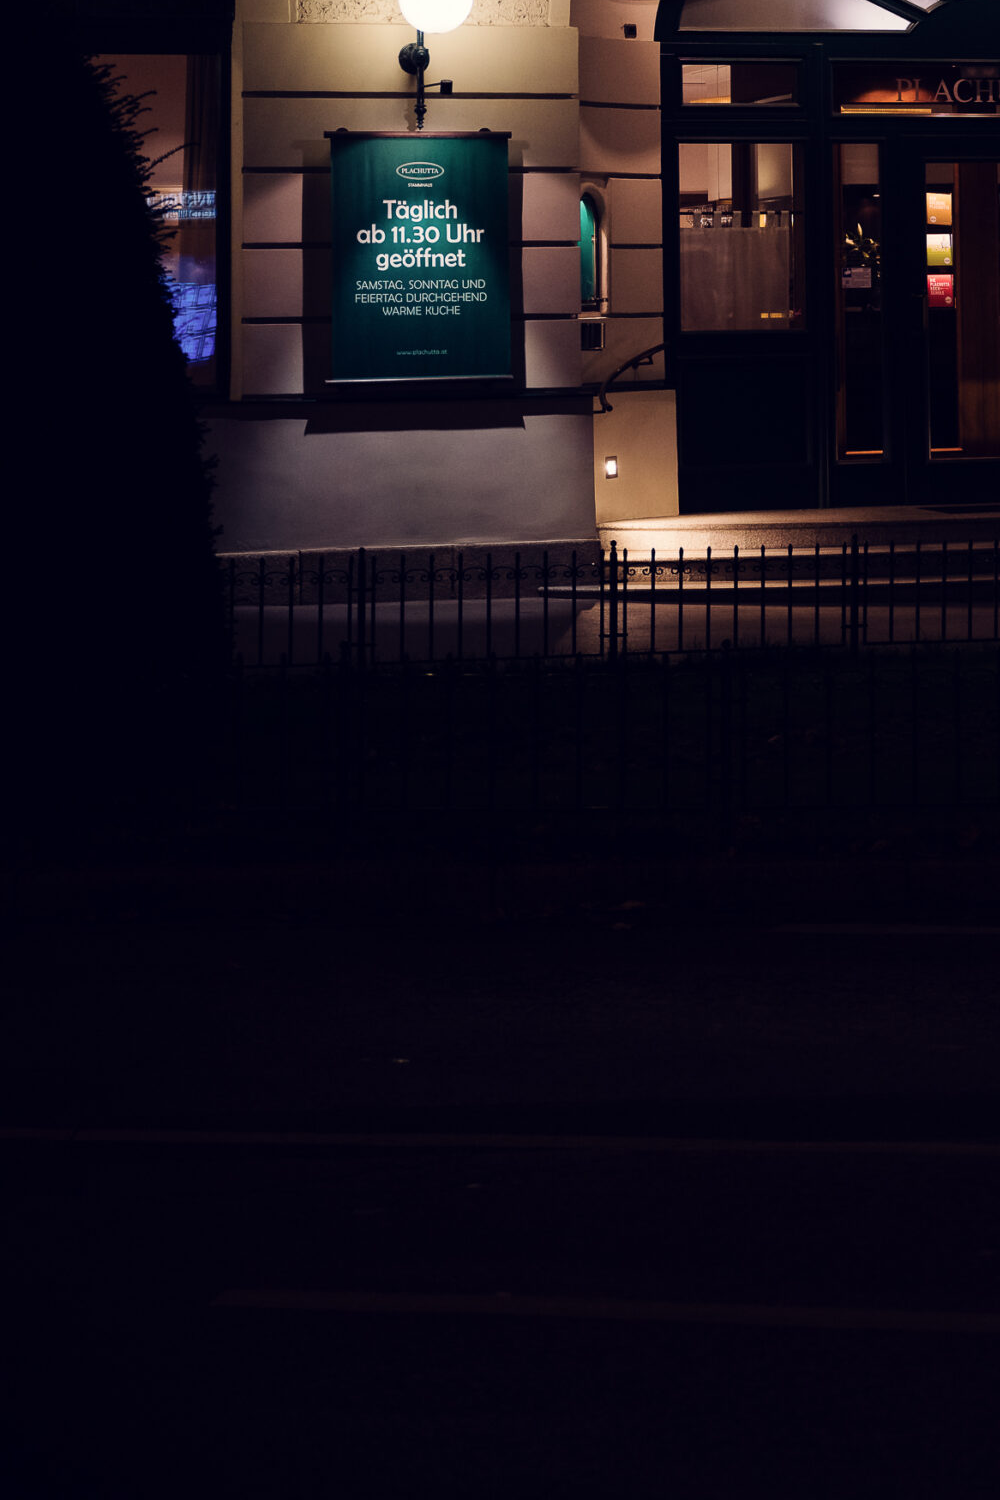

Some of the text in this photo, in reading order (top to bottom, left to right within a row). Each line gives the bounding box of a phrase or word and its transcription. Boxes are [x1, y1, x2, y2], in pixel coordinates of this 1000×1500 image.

[382, 199, 458, 222] Täglich
[356, 223, 485, 244] ab 11.30 Uhr
[376, 247, 467, 271] geöffnet
[355, 279, 486, 291] SAMSTAG, SONNTAG UND
[354, 292, 488, 304] FEIERTAG DURCHGEHEND
[382, 306, 422, 317] WARME
